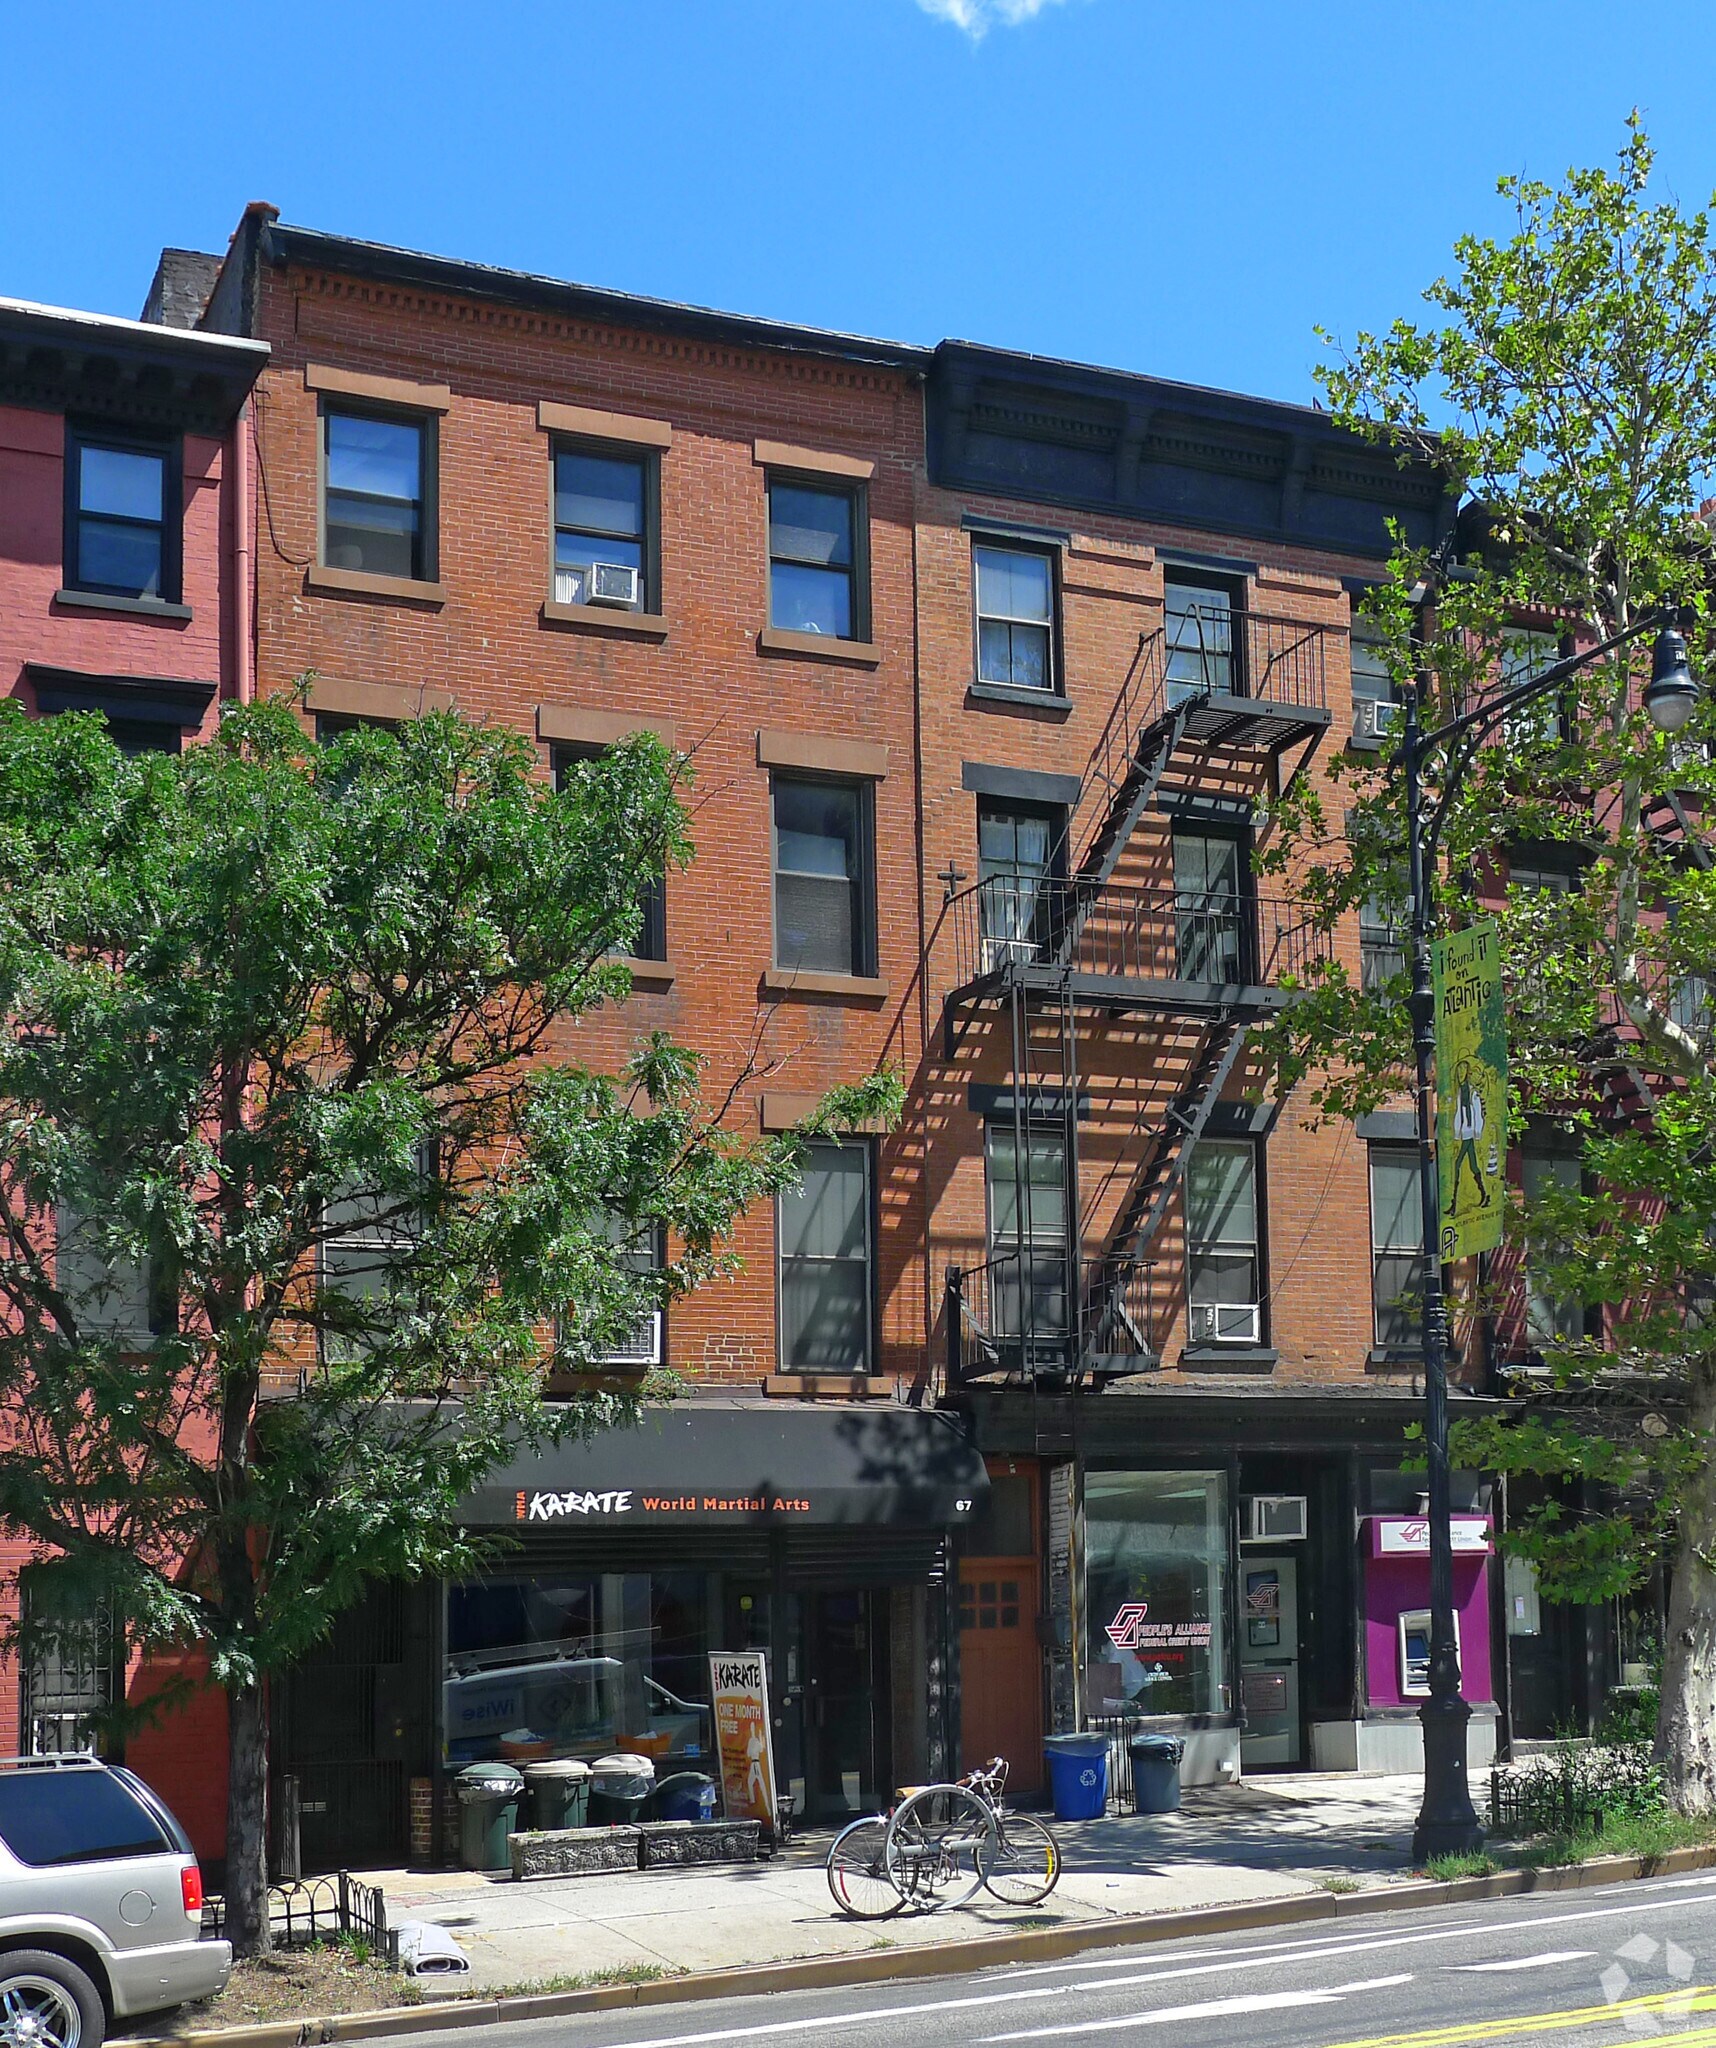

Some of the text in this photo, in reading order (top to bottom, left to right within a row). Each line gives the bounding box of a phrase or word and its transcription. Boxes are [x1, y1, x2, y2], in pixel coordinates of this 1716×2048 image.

[1447, 938, 1475, 971] found
[1455, 967, 1469, 981] on
[528, 1490, 810, 1521] KARATE World Martial Arts
[955, 1500, 972, 1511] 67
[1174, 1622, 1212, 1636] ALLIANCE
[719, 1662, 760, 1689] KARATE
[719, 1703, 761, 1719] ONE MONTH
[720, 1720, 738, 1734] FREE
